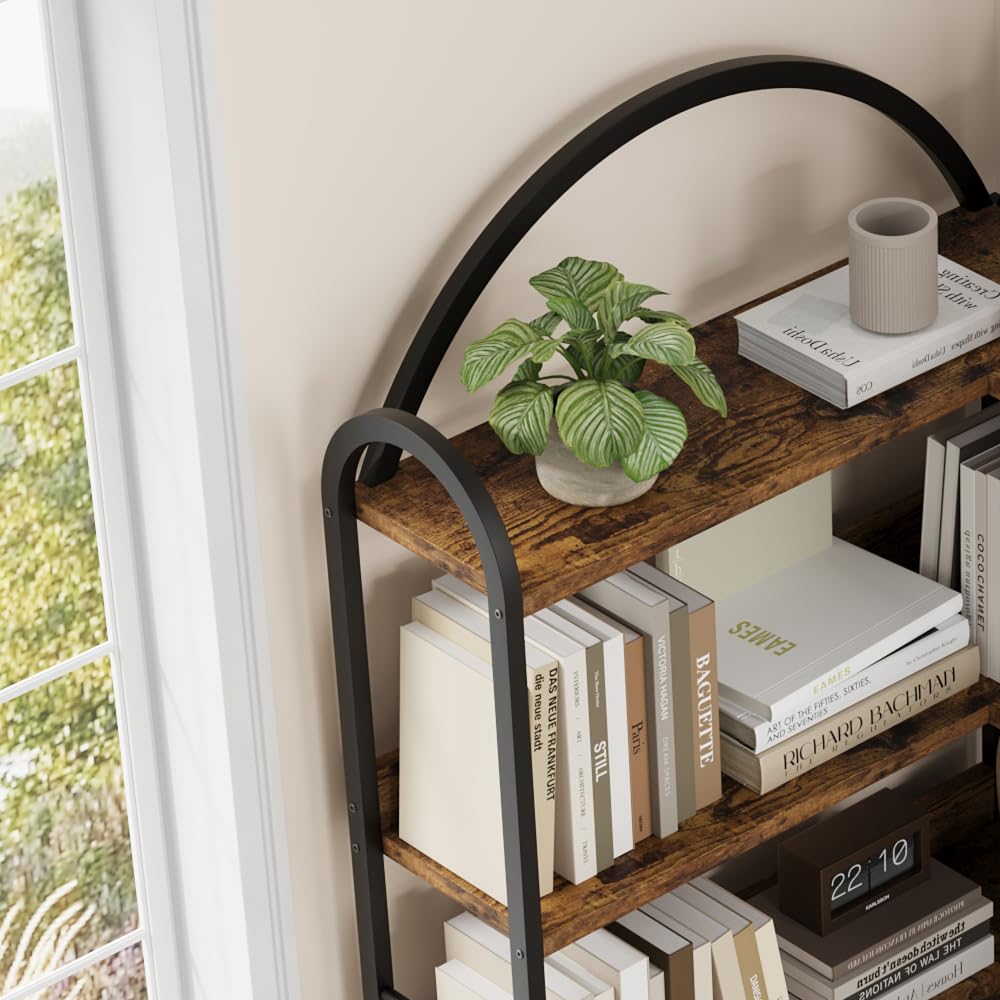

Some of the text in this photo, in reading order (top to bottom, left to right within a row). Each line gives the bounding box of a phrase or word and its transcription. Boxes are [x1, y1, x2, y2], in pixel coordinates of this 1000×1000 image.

[727, 619, 798, 657] EAMES
[656, 634, 668, 684] VICTORIA
[812, 665, 852, 695] EAMES
[533, 673, 543, 752] die neue stadt
[659, 684, 670, 721] HAGAN
[695, 651, 714, 769] BAGUETTE
[766, 721, 782, 736] ART
[783, 714, 796, 729] OF
[797, 704, 814, 721] THE
[782, 664, 957, 771] RICHARD BACHMAN
[545, 667, 558, 802] DAS NEUE FRANKFURT
[631, 720, 645, 755] Paris
[766, 706, 829, 744] AND SEVENTIES
[593, 740, 608, 783] STILL
[831, 838, 909, 901] 22 10
[865, 893, 890, 911] KARLSSON
